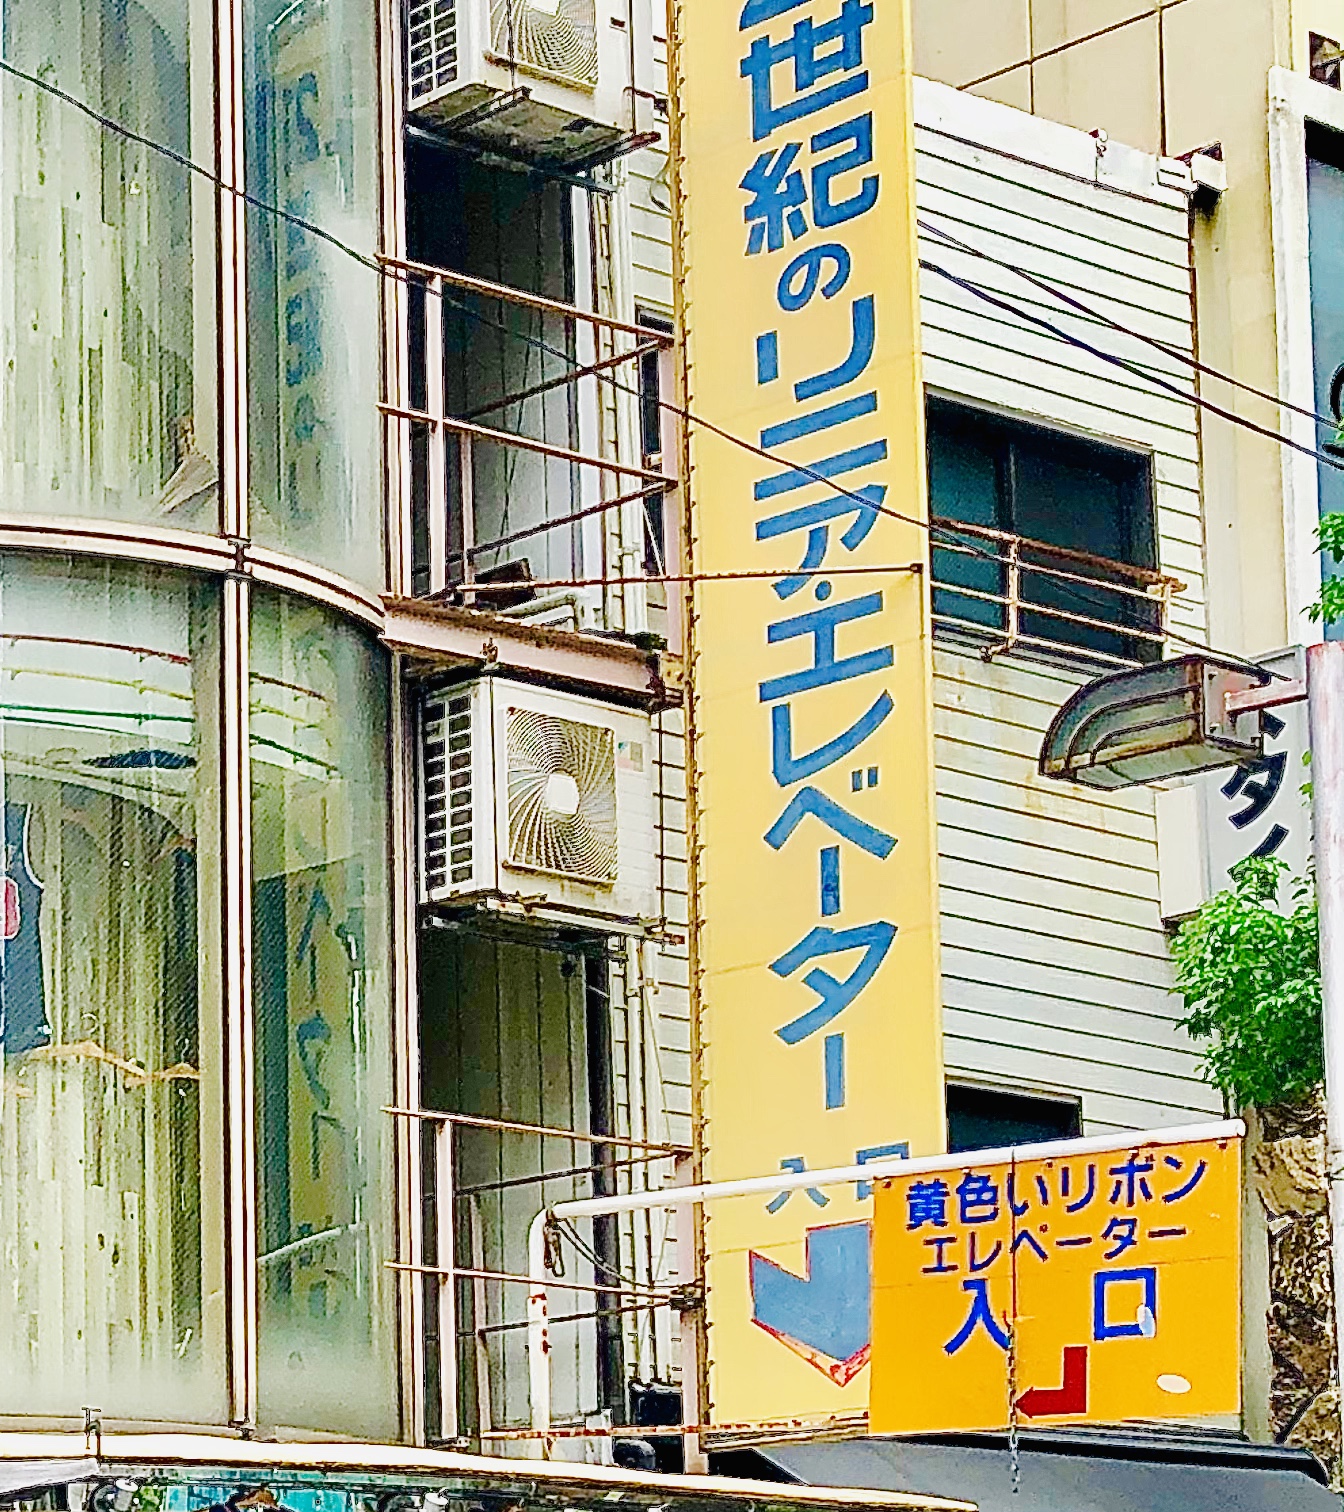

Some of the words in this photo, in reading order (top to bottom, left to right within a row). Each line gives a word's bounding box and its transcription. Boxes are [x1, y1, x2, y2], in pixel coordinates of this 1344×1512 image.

[738, 0, 899, 1109] 世紀のリニア・エレベーター
[906, 1155, 1207, 1232] 黄色いリボン
